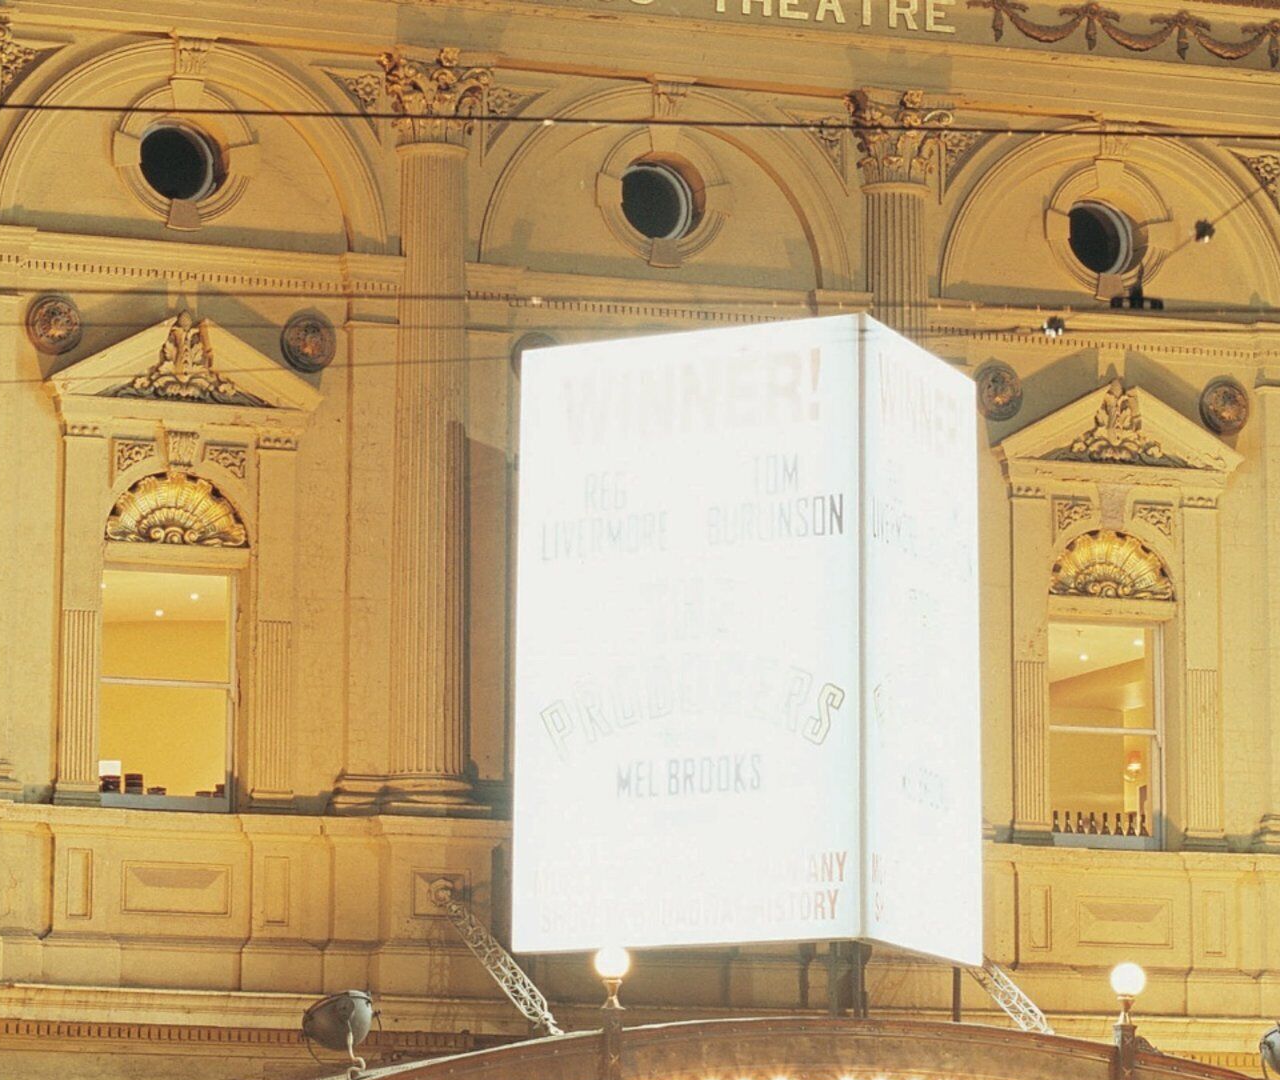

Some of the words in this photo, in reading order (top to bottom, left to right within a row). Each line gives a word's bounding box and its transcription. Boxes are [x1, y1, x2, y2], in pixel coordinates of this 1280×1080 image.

[584, 471, 628, 512] REG
[753, 452, 799, 496] TOM
[540, 509, 669, 561] LIVERMORE
[706, 493, 844, 547] BURLINSON
[617, 761, 658, 798] MEL
[667, 753, 761, 796] BROOKS
